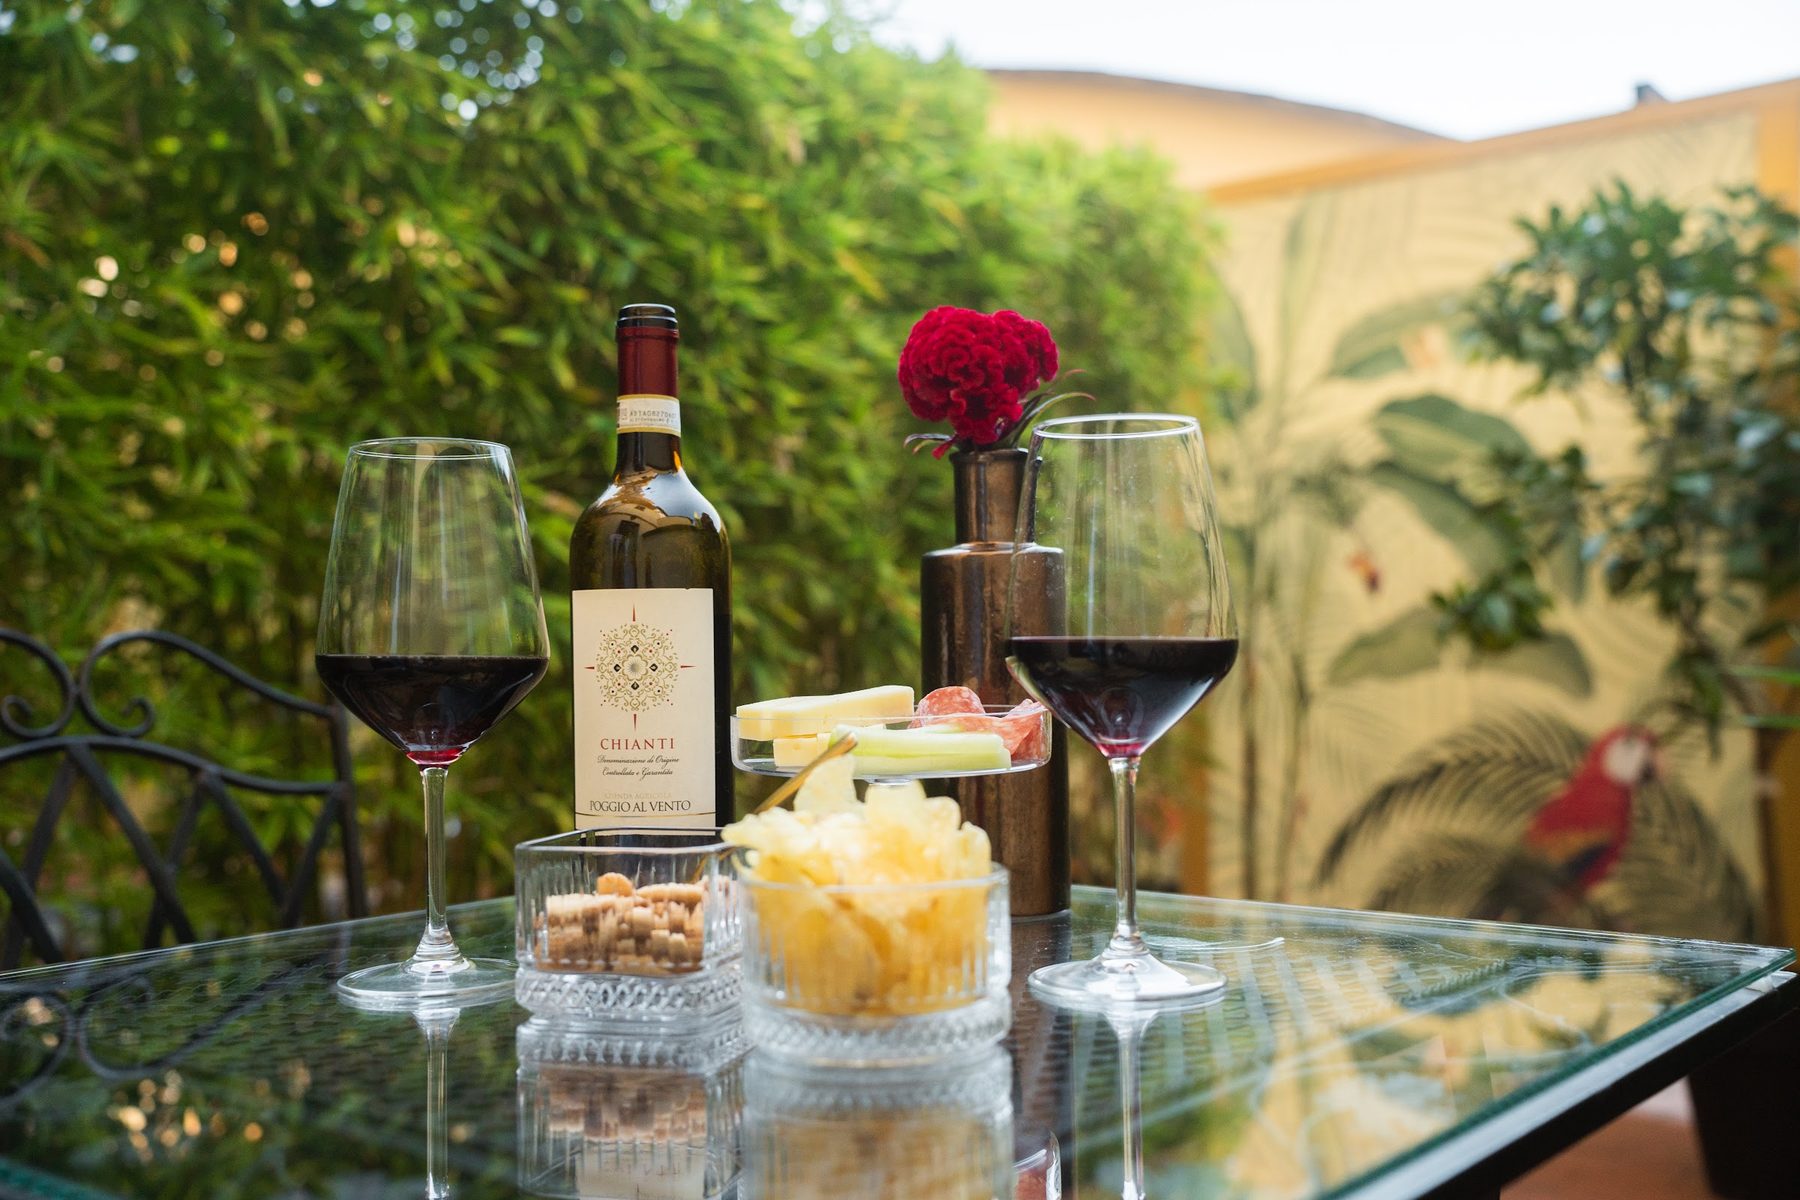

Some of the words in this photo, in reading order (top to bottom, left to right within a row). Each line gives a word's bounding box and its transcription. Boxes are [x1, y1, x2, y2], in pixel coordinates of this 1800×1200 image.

[600, 738, 675, 750] CHIANTI
[597, 755, 646, 764] Denominazione
[646, 755, 655, 764] di
[655, 755, 680, 767] Origine
[602, 767, 635, 776] Controllata
[640, 767, 674, 780] Garantita
[590, 800, 631, 812] POGGIO
[632, 801, 648, 812] AL
[649, 799, 691, 812] VENTO
